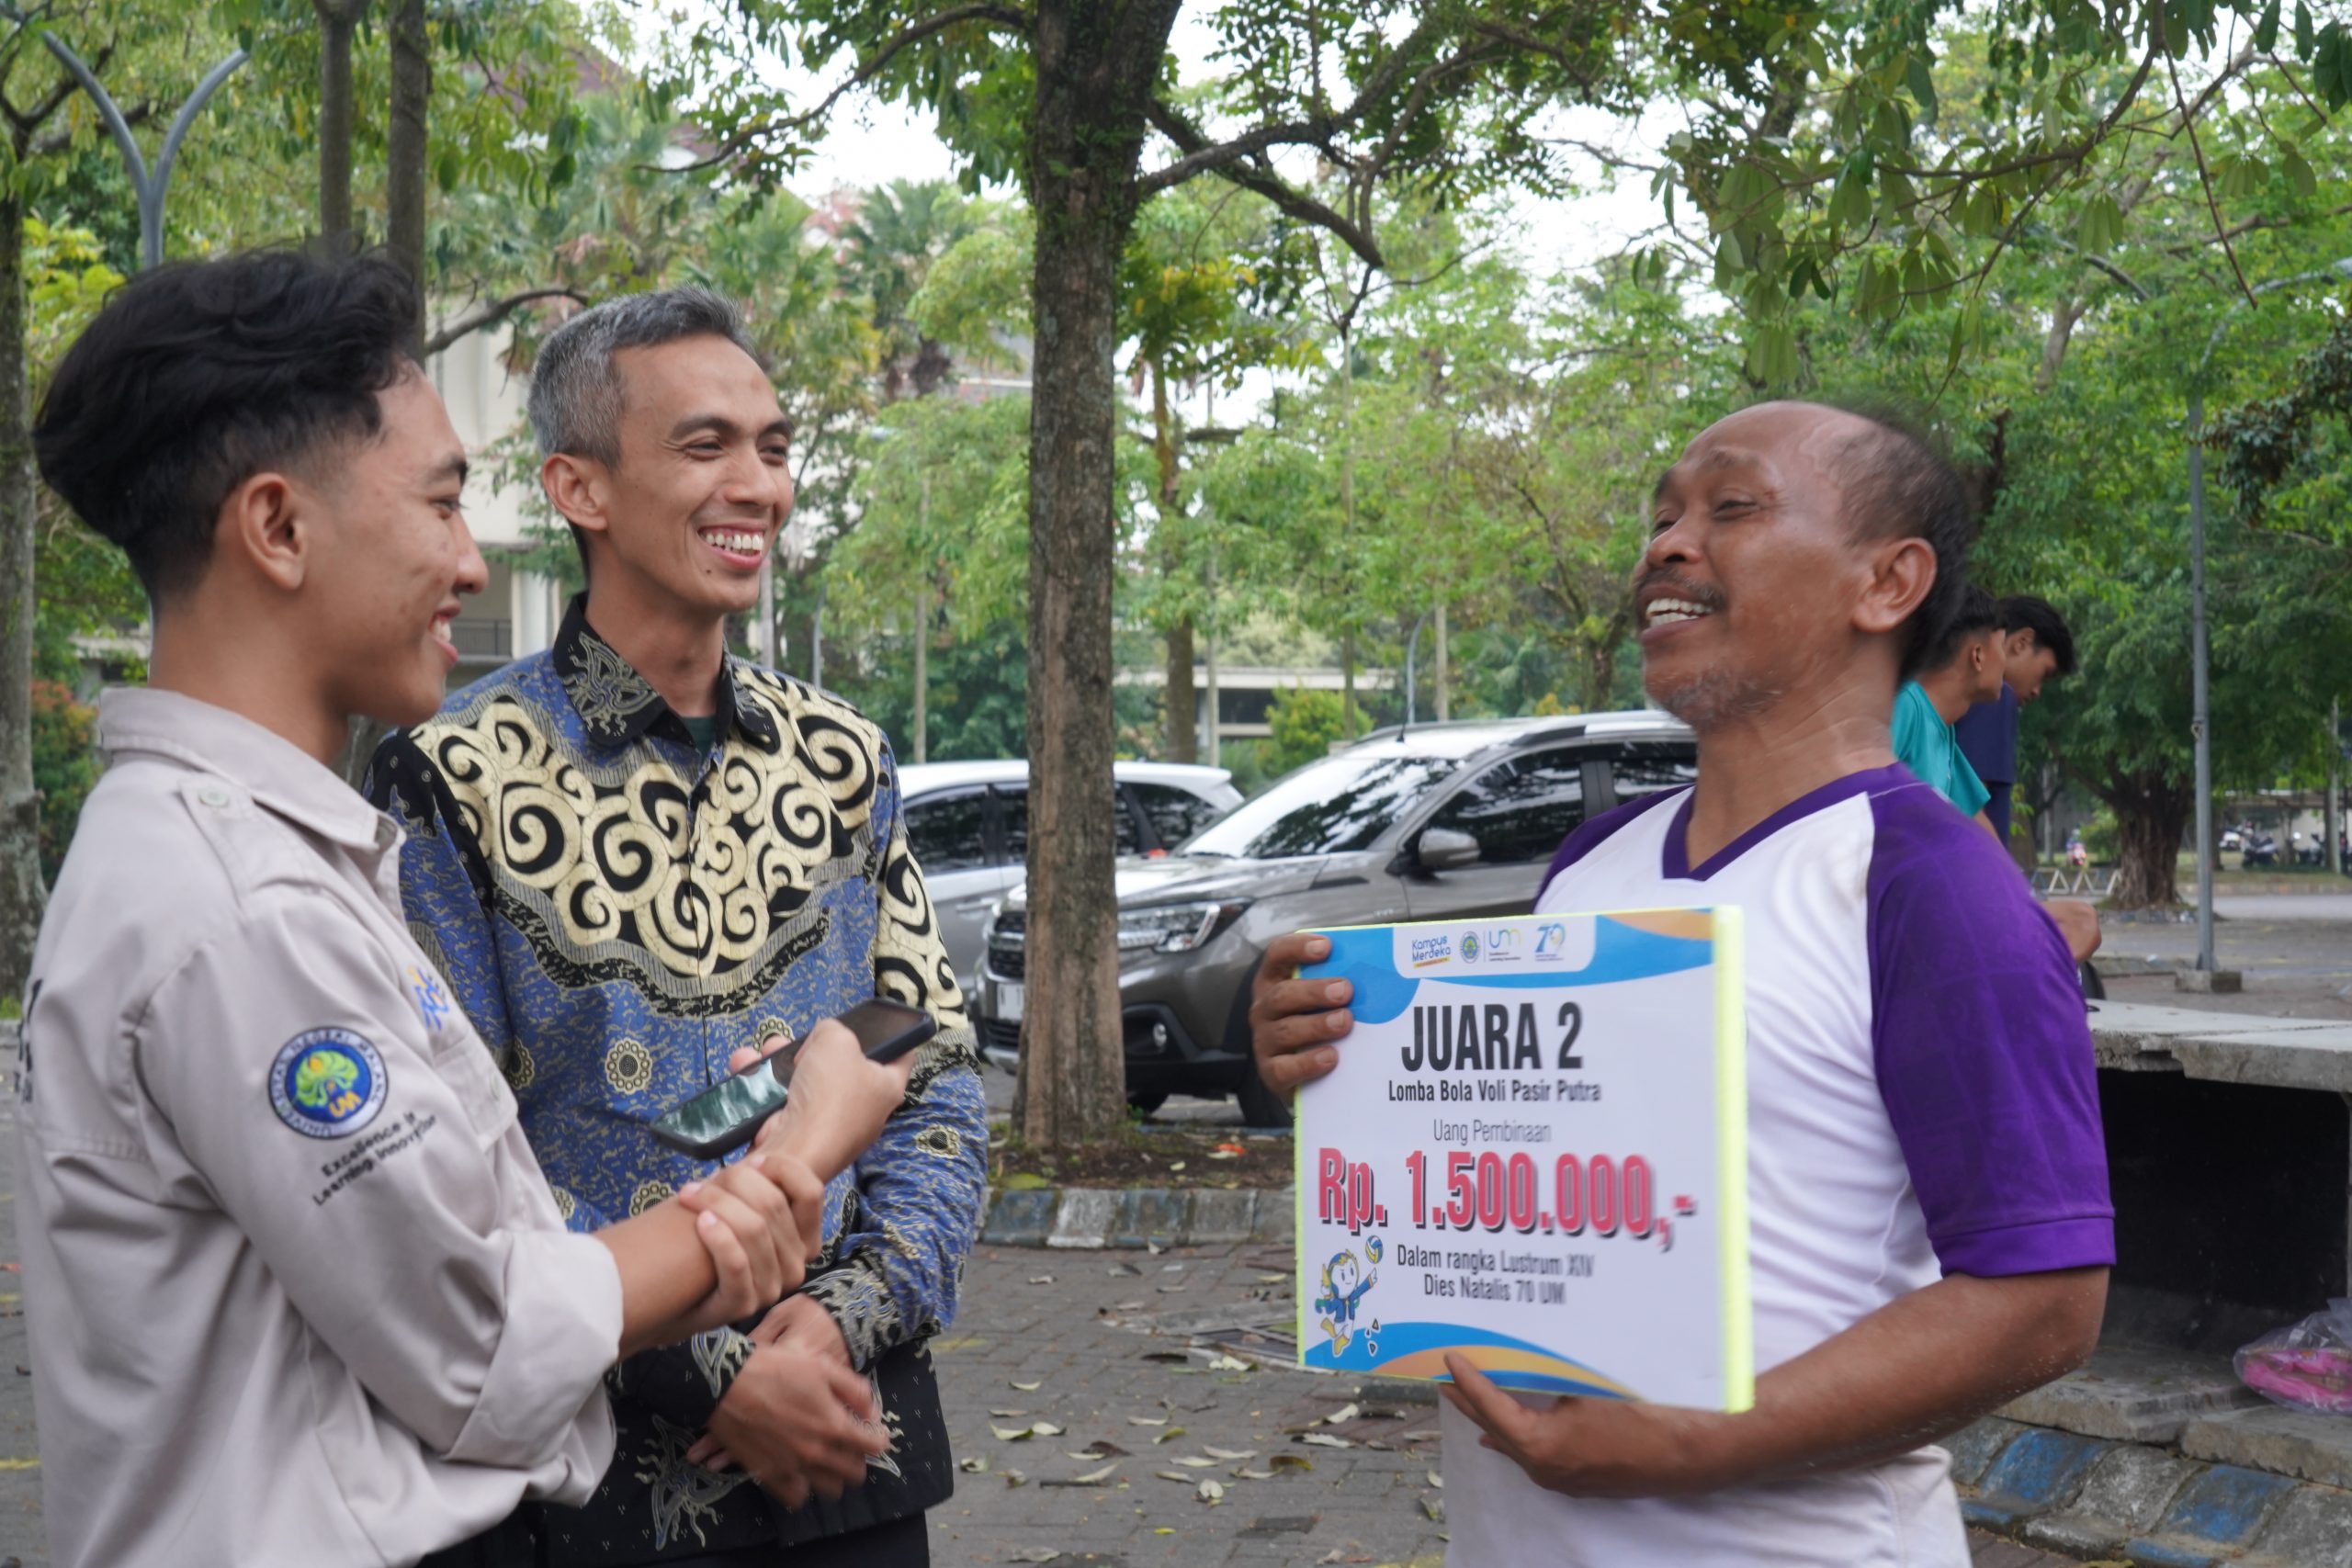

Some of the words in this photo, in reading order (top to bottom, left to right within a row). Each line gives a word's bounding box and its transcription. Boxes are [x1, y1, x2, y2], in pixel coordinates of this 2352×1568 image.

[1411, 935, 1448, 951] Kampus
[1411, 947, 1452, 962] Merdeka
[1401, 1002, 1543, 1072] JUARA
[1557, 1000, 1584, 1070] 2
[1388, 1079, 1435, 1102] Lomba
[1440, 1079, 1473, 1102] Bola
[1477, 1079, 1507, 1102] Voli
[1512, 1078, 1552, 1101] Pasir
[1556, 1078, 1602, 1102] Putra
[1433, 1119, 1469, 1146] Uang
[1473, 1119, 1553, 1143] Pembinaan
[322, 1122, 401, 1177] Excellence
[312, 1156, 375, 1207] Learning
[1317, 1146, 1389, 1236] Rp.
[1406, 1149, 1697, 1253] 1.500.000,-
[1397, 1244, 1442, 1269] Dalam
[1446, 1249, 1496, 1275] rangka
[1500, 1250, 1562, 1276] Lustrum
[1566, 1253, 1596, 1278] XIV
[1424, 1273, 1455, 1298] Dies
[1460, 1276, 1511, 1302] Natalis
[1516, 1279, 1534, 1303] 70
[1538, 1280, 1566, 1304] UM
